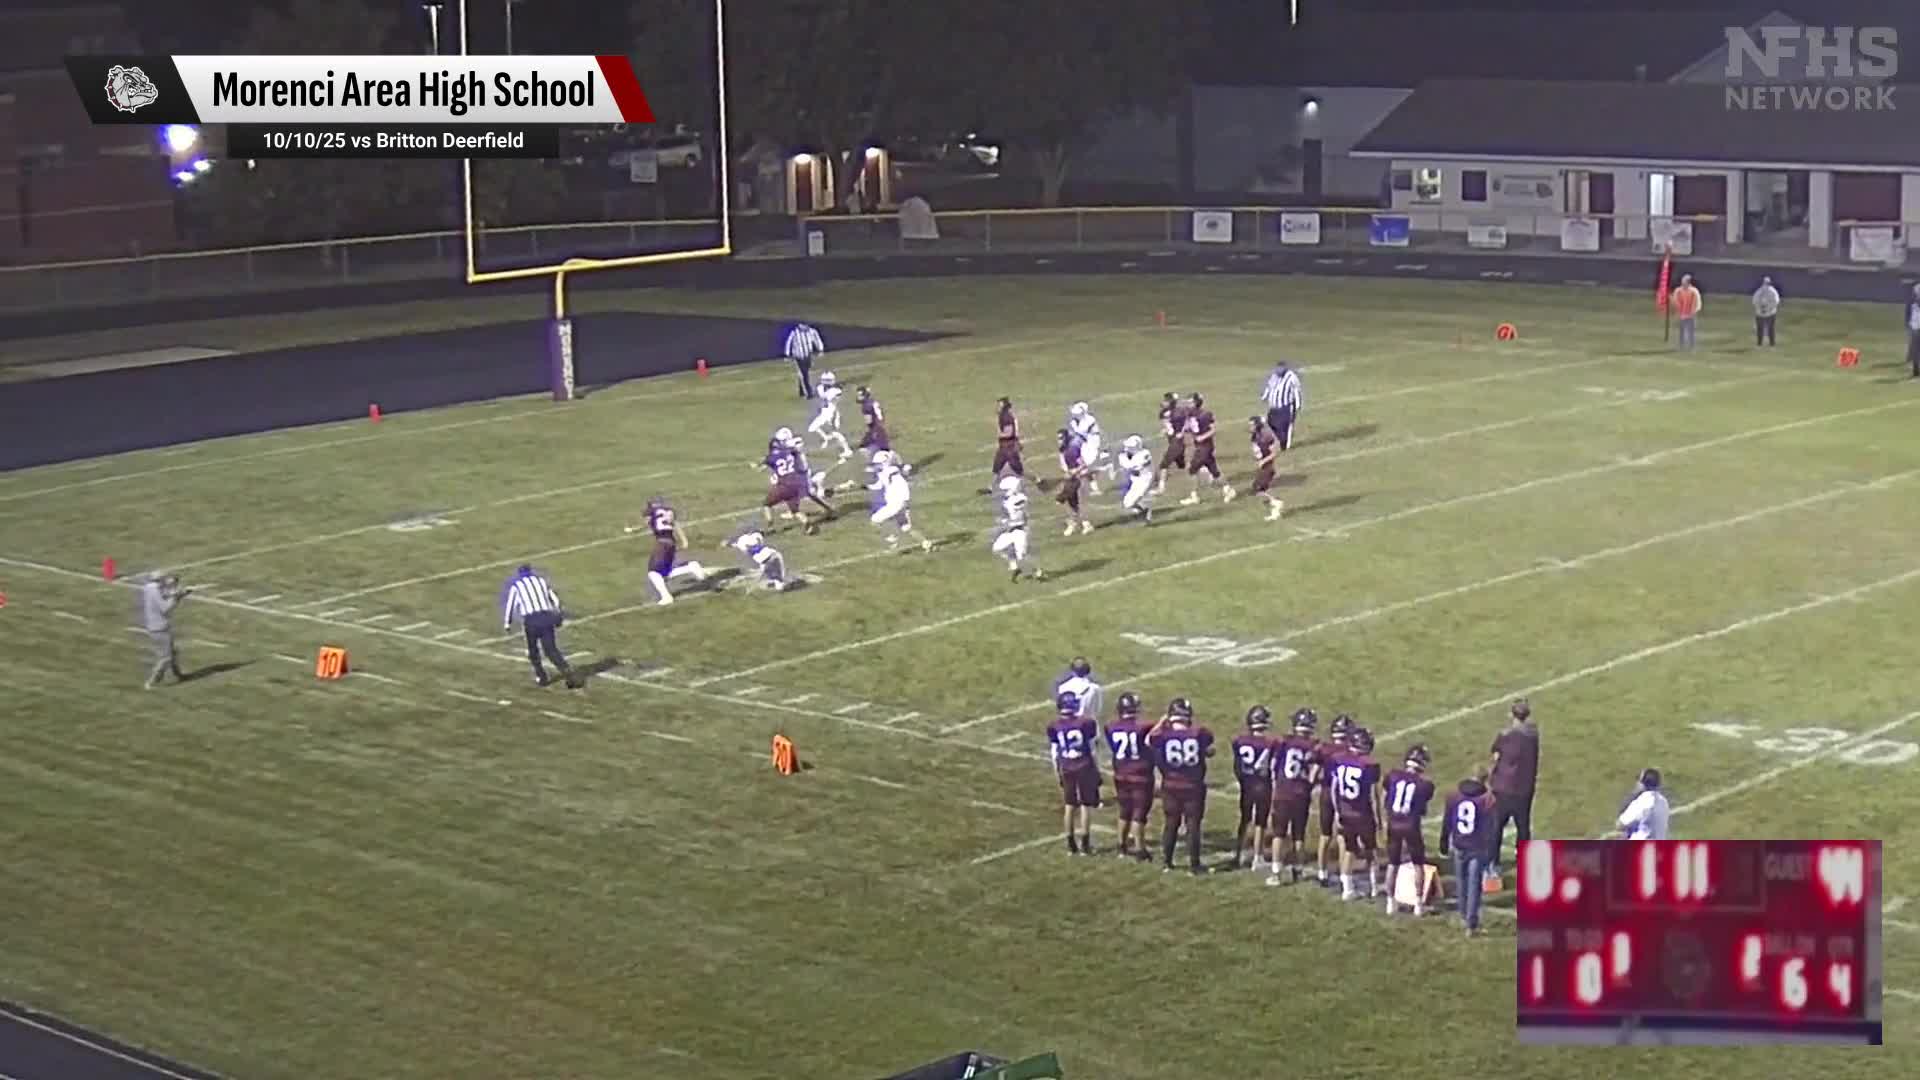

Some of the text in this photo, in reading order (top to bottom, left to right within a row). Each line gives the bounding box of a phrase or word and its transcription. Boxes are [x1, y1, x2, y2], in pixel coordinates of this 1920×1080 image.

[776, 453, 795, 476] 22
[322, 651, 339, 677] 10
[1056, 729, 1084, 759] 12
[1112, 731, 1140, 760] 71
[1165, 738, 1199, 767] 68
[1239, 745, 1270, 776] 24
[1336, 764, 1362, 799] 15
[1392, 780, 1416, 814] 11
[1456, 800, 1476, 834] 9
[1781, 956, 1808, 1008] 6
[1829, 962, 1851, 1006] 4
